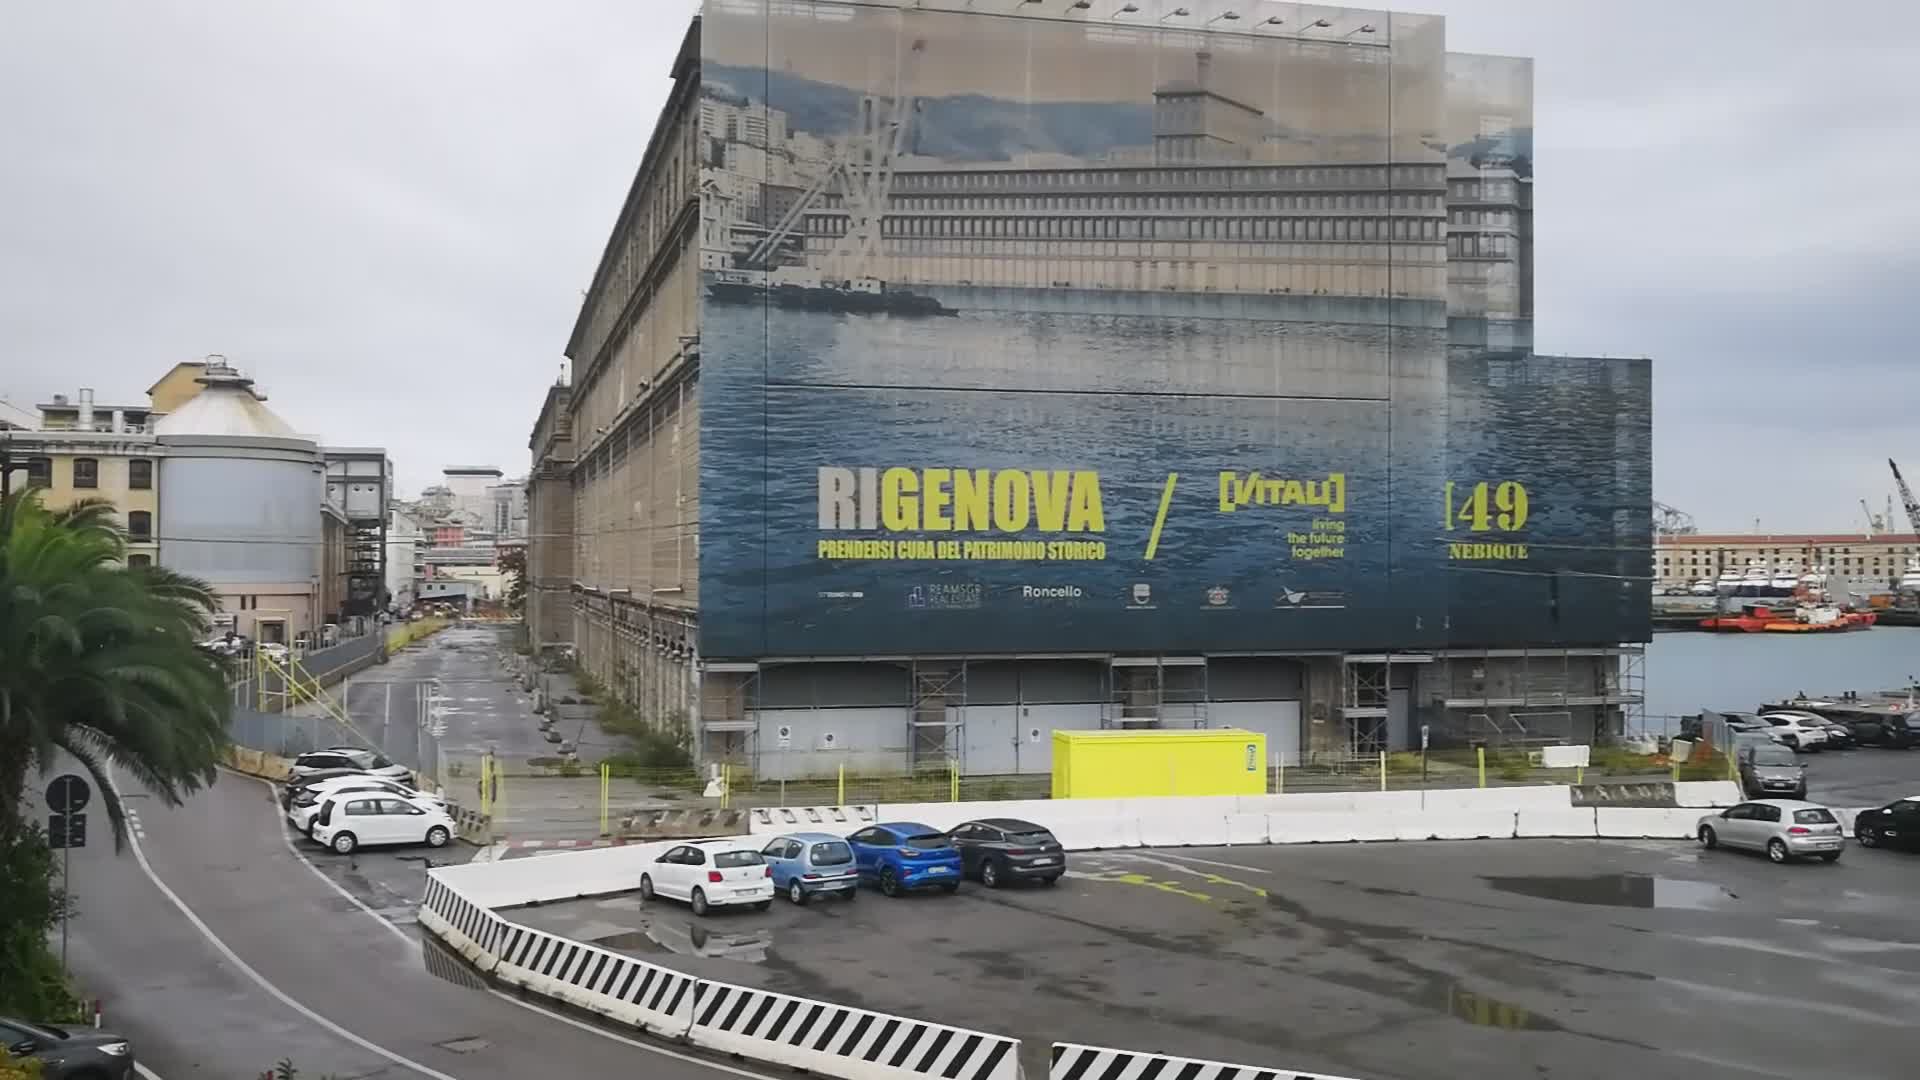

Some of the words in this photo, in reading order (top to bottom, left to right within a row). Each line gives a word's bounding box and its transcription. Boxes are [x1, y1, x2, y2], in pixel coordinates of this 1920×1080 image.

[818, 467, 1105, 532] RIGENOVA
[1312, 518, 1345, 532] living
[1287, 532, 1307, 544] the
[1310, 532, 1345, 544] future
[818, 540, 895, 559] PRENDERSI
[897, 540, 935, 559] CURA
[937, 541, 961, 559] DEL
[963, 541, 1046, 560] PATRIMONIO
[1047, 541, 1106, 560] STORICO
[1291, 545, 1345, 560] together
[1449, 543, 1529, 560] NEBIQUE
[1023, 585, 1082, 597] Roncello
